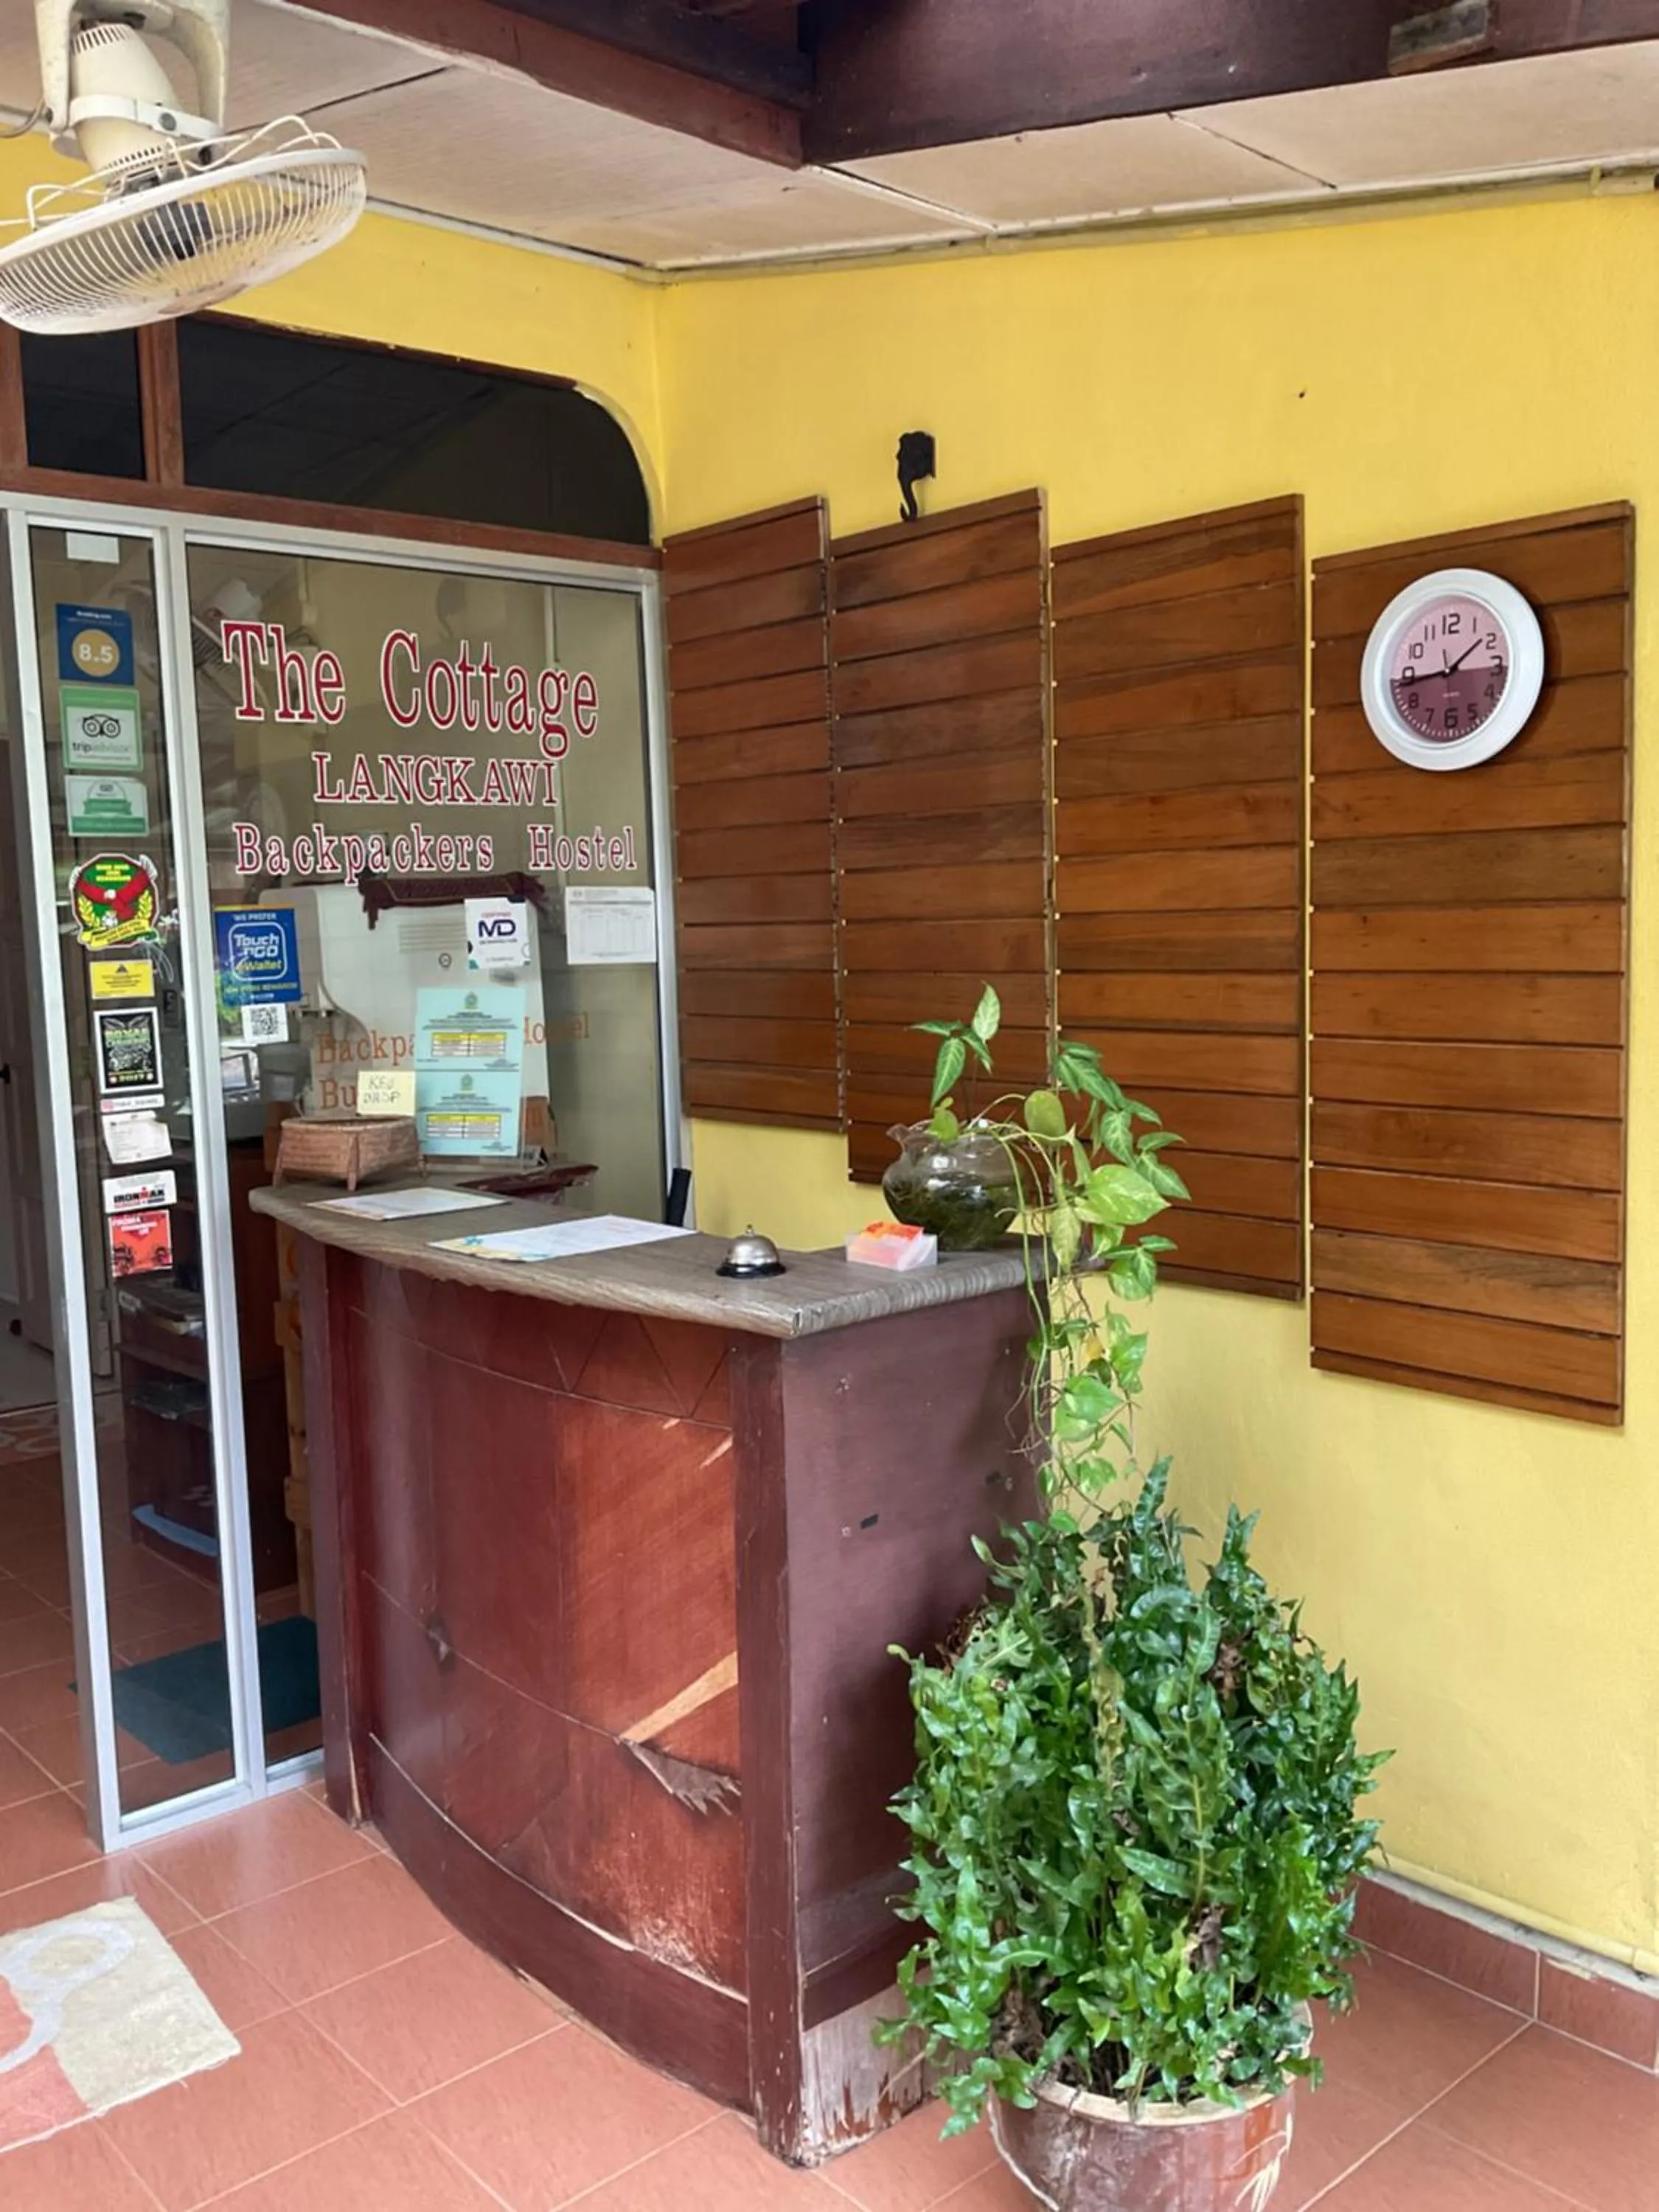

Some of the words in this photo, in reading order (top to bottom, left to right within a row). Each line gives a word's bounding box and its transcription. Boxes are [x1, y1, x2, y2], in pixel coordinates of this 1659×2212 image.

[1425, 625, 1435, 641] 11
[1442, 613, 1460, 636] 12
[1472, 616, 1477, 633] 1
[1486, 633, 1496, 650] 2
[79, 643, 114, 664] 8.5
[1409, 642, 1424, 660] 10
[1489, 655, 1503, 677] 3
[1402, 666, 1415, 686] 9
[221, 620, 346, 725] The
[380, 629, 599, 759] Cottage
[1484, 684, 1495, 701] 4
[1408, 692, 1419, 709] 8
[1425, 707, 1435, 723] 7
[1444, 706, 1458, 729] 6
[1467, 703, 1478, 720] 5
[311, 751, 558, 806] LANGKAWI
[232, 822, 495, 886] Backpackers
[527, 824, 637, 870] Hostel
[234, 933, 279, 947] Touch
